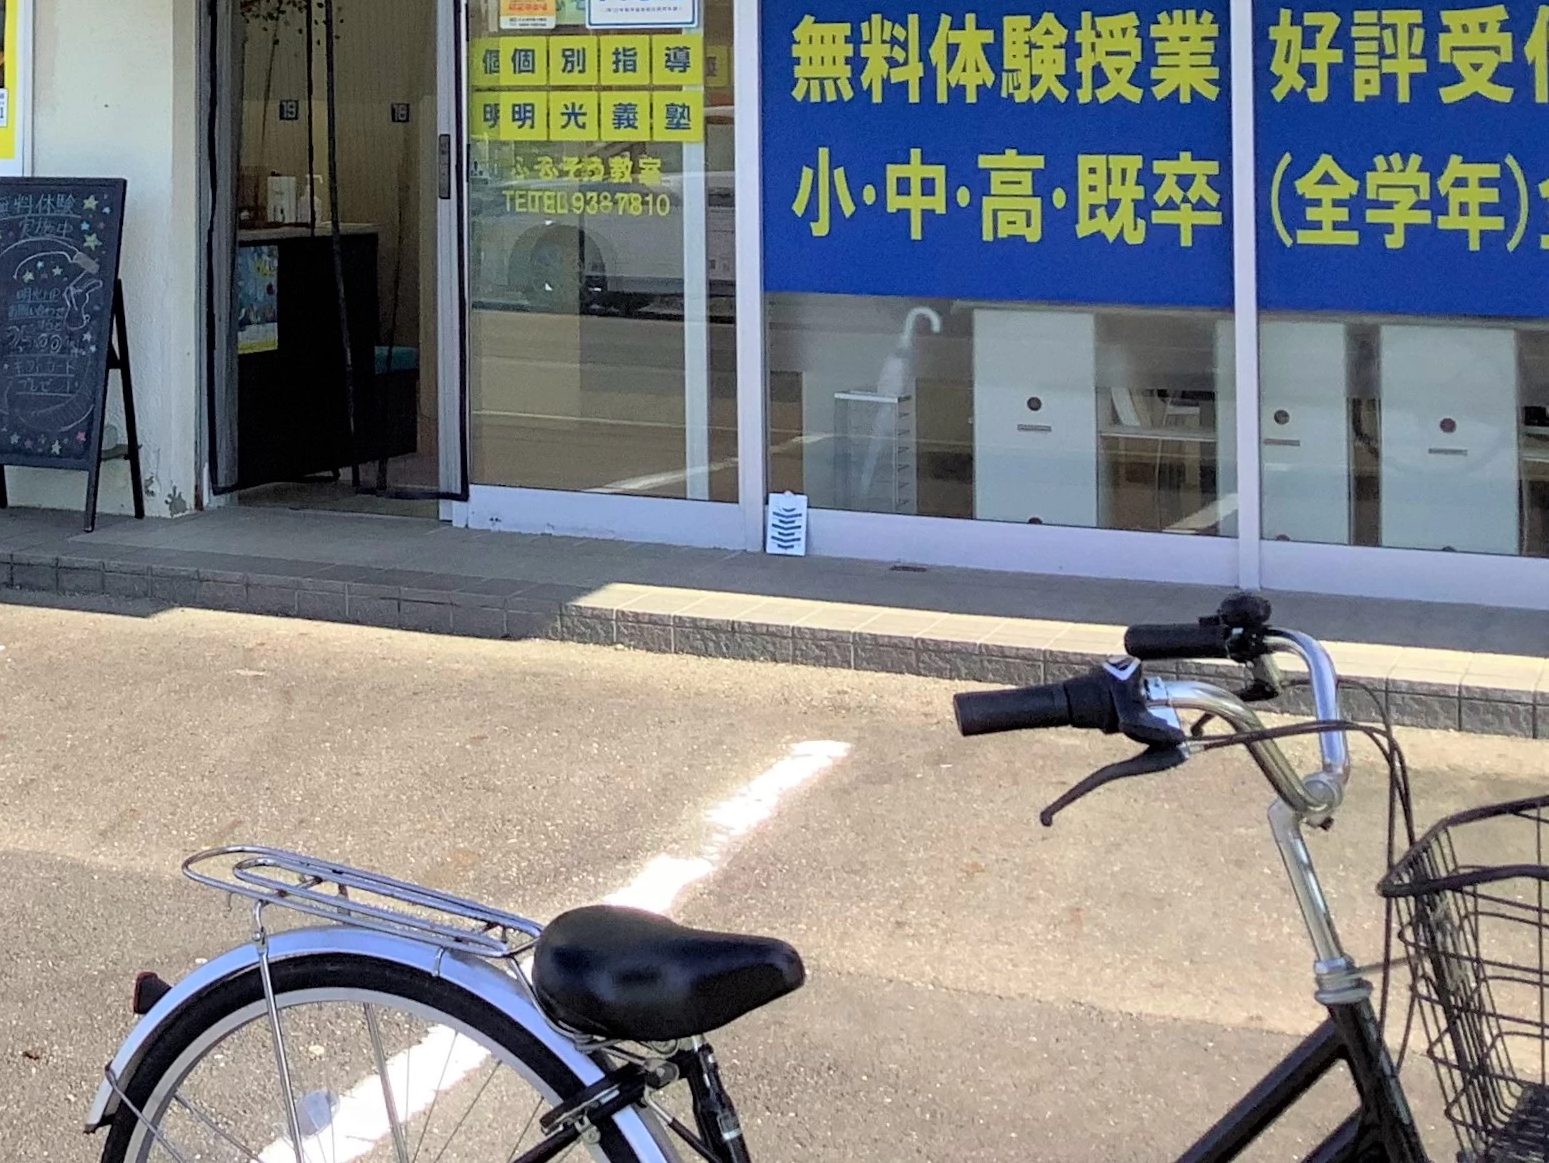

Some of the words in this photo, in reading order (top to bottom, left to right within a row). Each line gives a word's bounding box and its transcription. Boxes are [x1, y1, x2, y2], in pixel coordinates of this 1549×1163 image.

[511, 46, 691, 75] 個別指導
[791, 8, 1221, 105] 無料体験授業
[511, 101, 692, 130] 明光義塾
[791, 146, 1224, 249] 小・中・高・既卒
[1270, 151, 1549, 254] (全学年)
